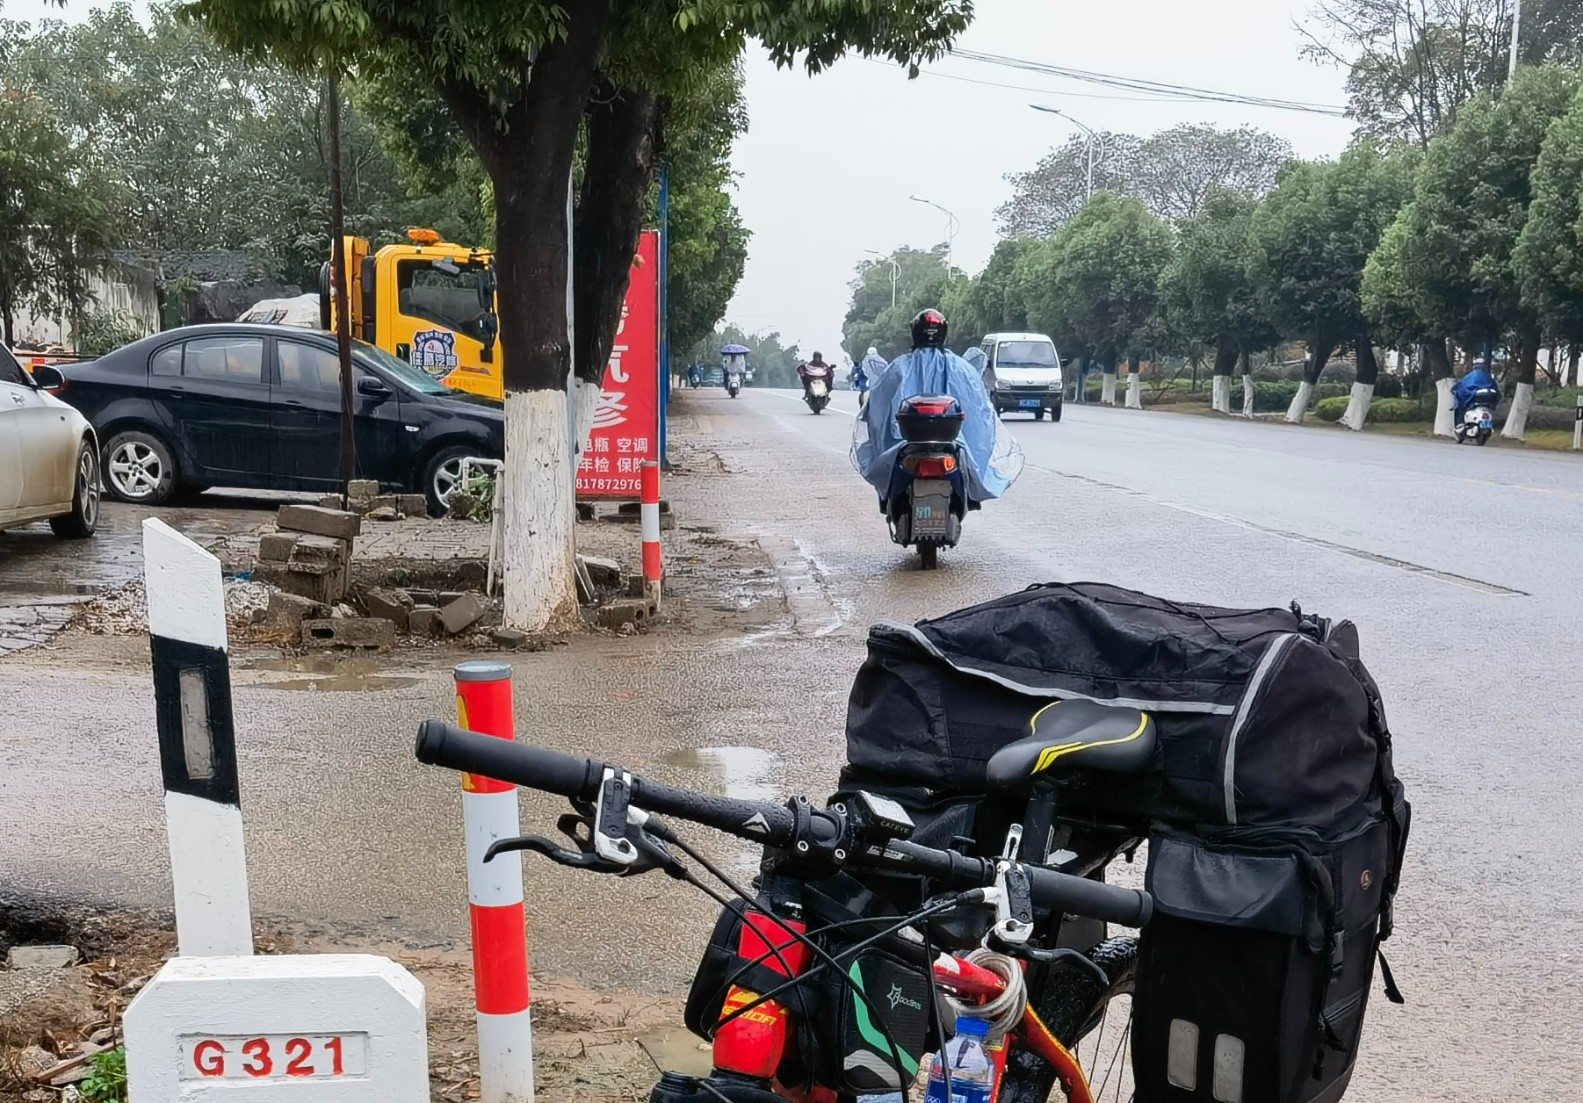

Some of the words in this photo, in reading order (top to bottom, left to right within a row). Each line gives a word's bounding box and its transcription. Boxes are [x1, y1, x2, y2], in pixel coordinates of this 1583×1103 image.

[616, 437, 648, 453] 空调
[578, 457, 610, 473] 年检
[193, 1036, 344, 1077] G321
